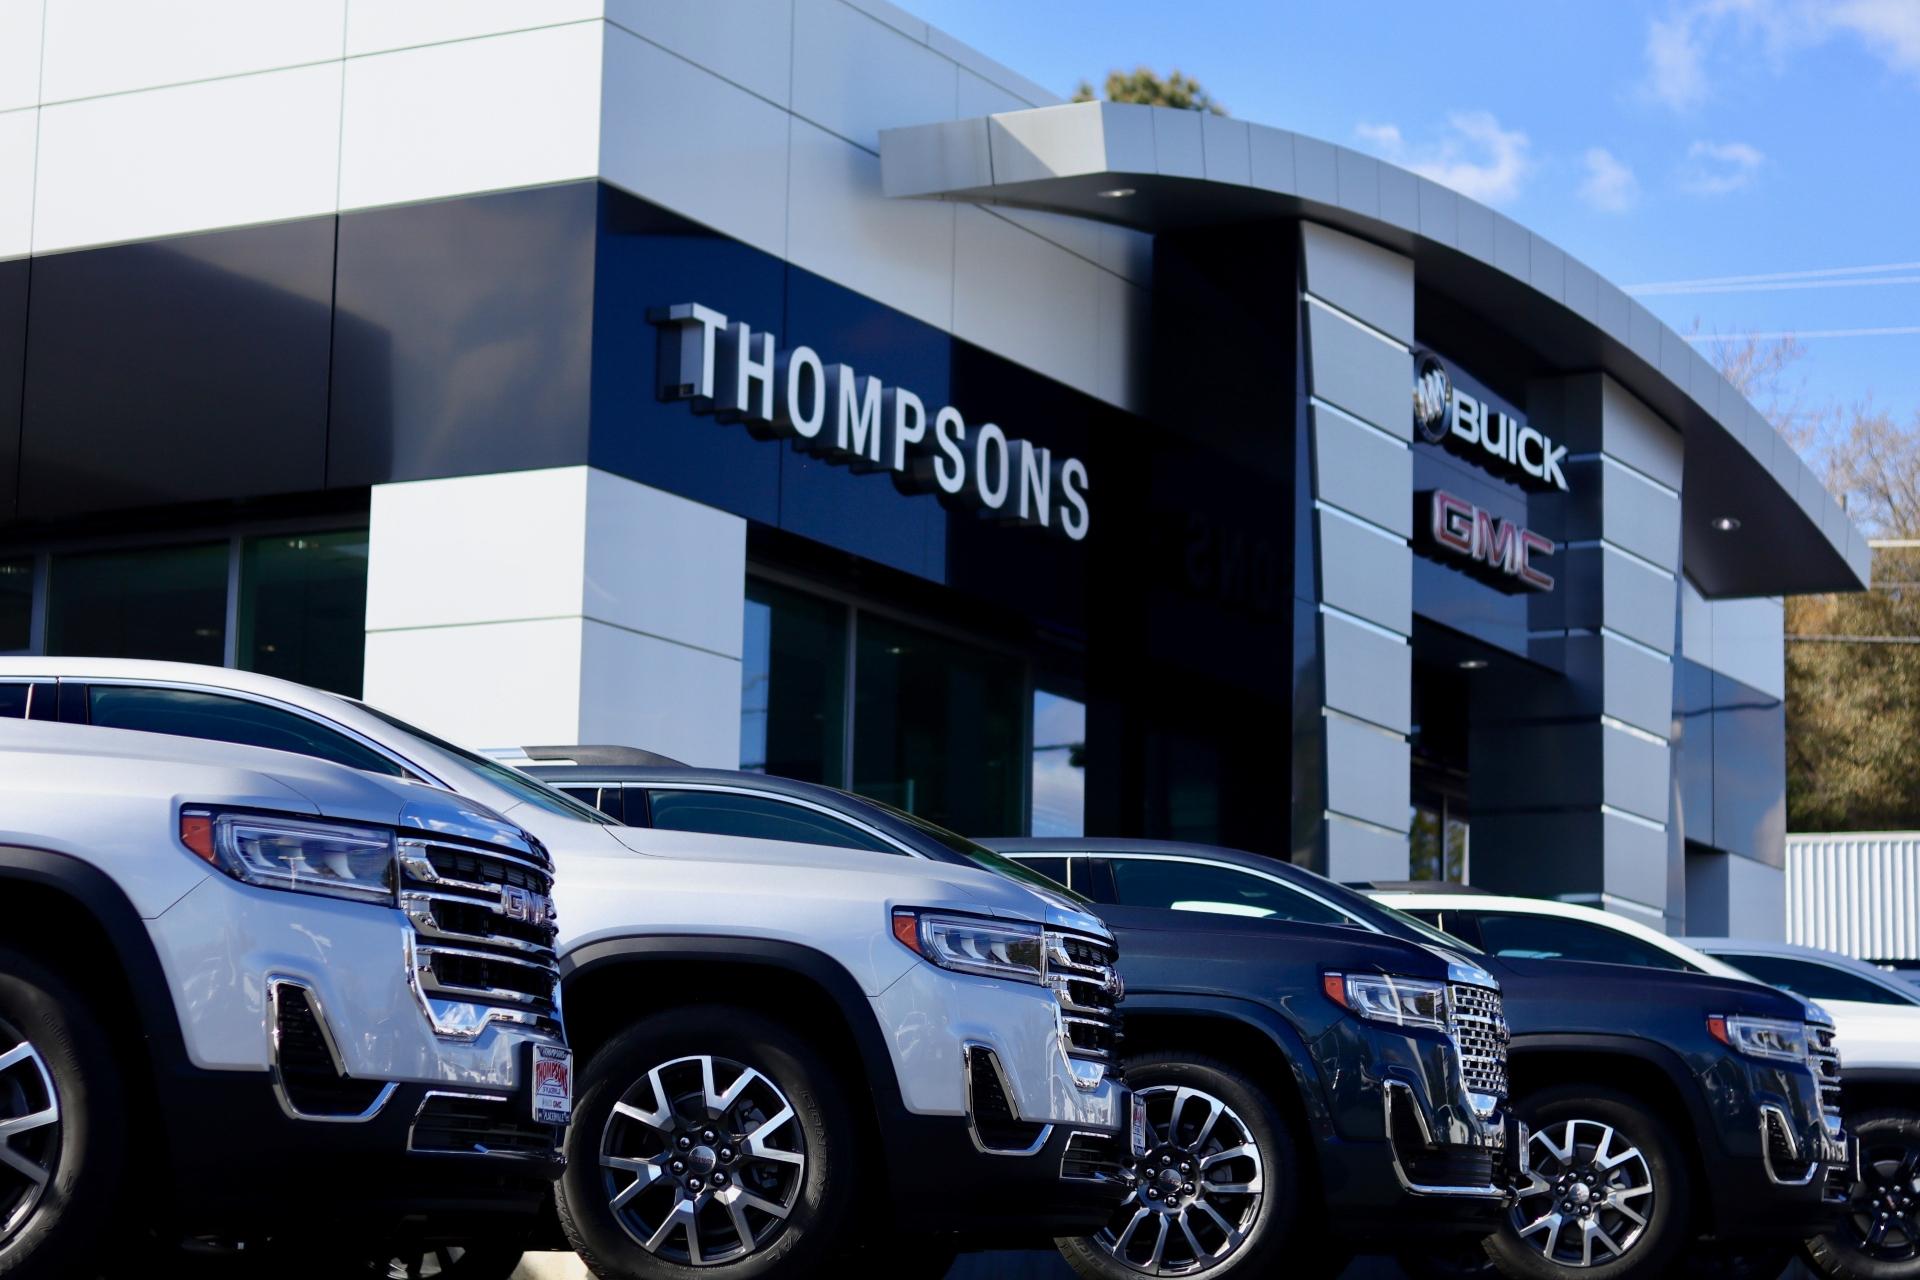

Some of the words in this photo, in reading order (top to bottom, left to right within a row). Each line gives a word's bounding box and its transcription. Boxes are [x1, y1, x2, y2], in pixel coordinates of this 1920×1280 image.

[690, 302, 1089, 540] THOMPSONS
[1451, 388, 1570, 492] BUICK
[1433, 489, 1554, 592] GMC
[536, 1061, 568, 1097] THOMPSONS
